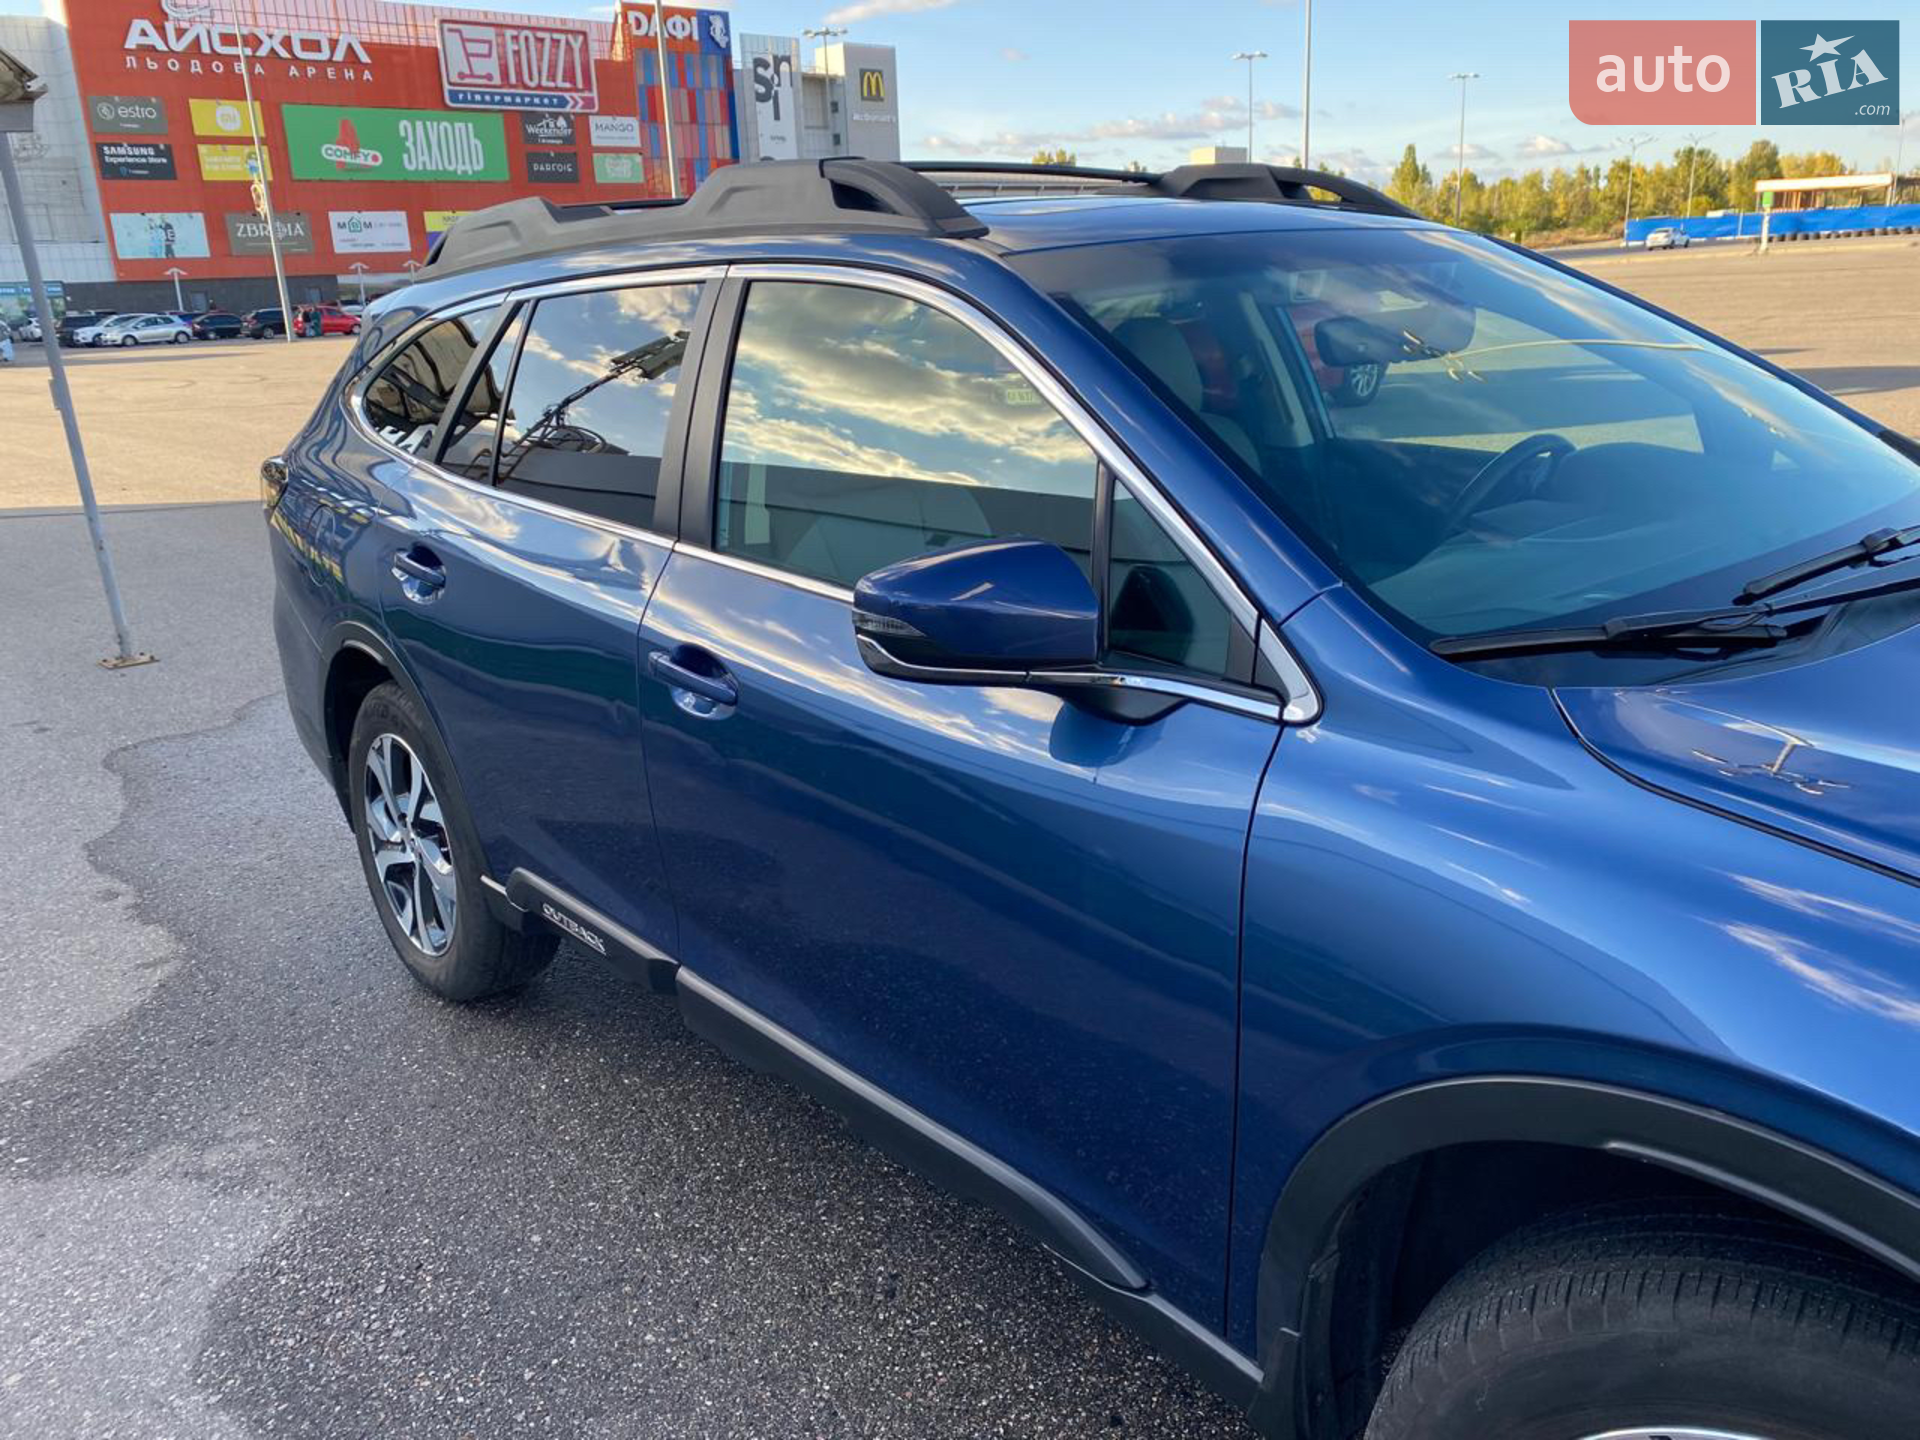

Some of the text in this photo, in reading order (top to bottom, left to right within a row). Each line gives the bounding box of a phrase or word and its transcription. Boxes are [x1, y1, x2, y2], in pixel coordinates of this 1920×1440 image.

[125, 55, 373, 82] ЛЬОДОВА АРЕНА
[504, 29, 583, 89] FOZZY
[117, 104, 157, 119] estro
[595, 123, 634, 133] MANGO
[103, 145, 156, 156] SAMSUNG
[324, 147, 370, 164] COMFY
[400, 120, 484, 175] ЗАХОДЬ
[542, 902, 607, 955] OUTBACK
